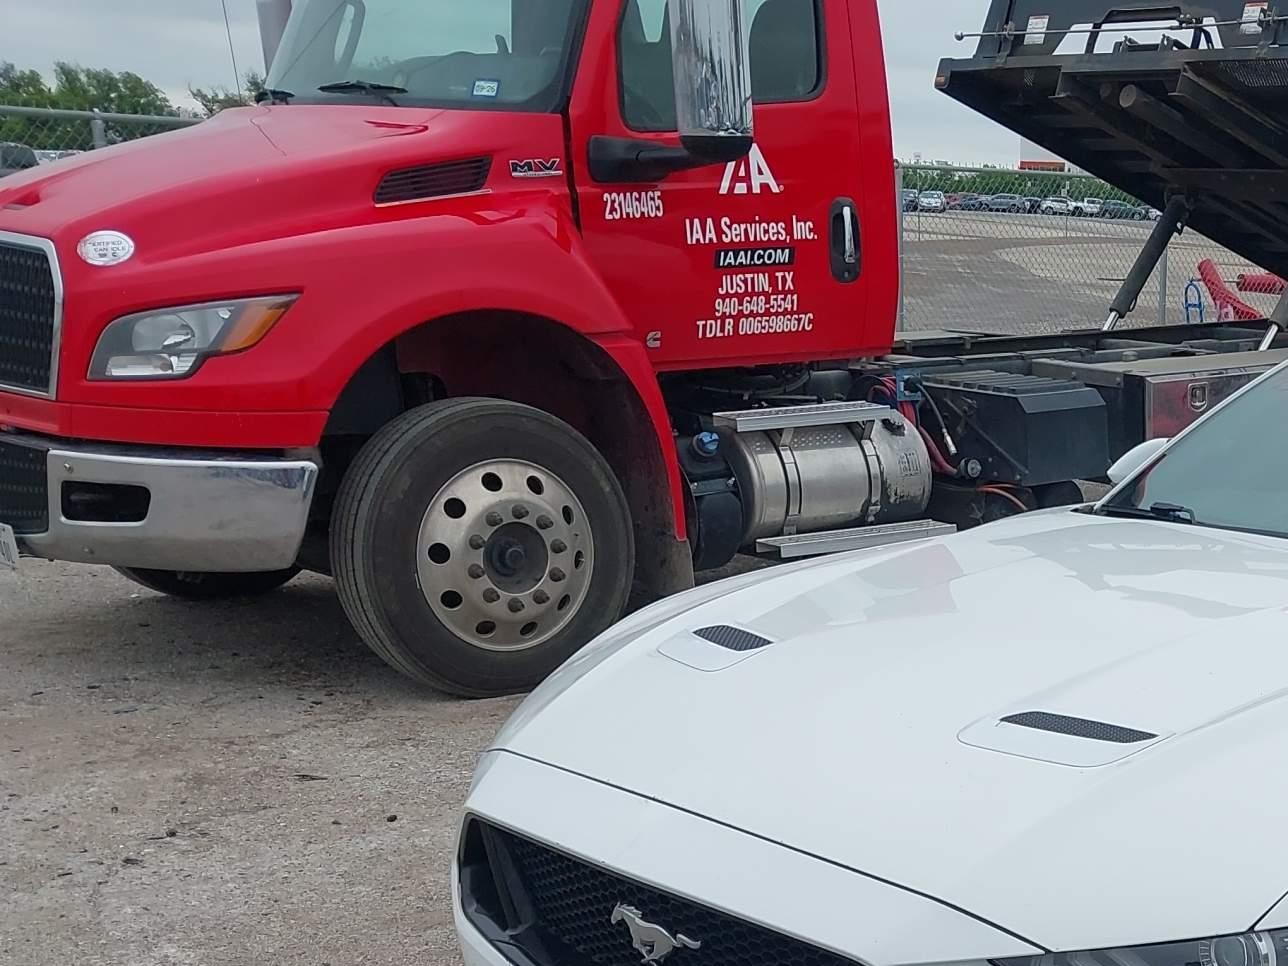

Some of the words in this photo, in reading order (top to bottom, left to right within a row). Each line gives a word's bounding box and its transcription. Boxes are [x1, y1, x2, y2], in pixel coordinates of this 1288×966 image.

[509, 158, 560, 173] MV
[603, 191, 664, 220] 23146465
[685, 218, 717, 245] IAA
[721, 215, 790, 245] Services,
[792, 215, 818, 241] Inc.
[720, 249, 790, 267] IAAI.COM
[718, 272, 773, 295] JUSTIN,
[775, 271, 795, 291] TX
[715, 294, 798, 317] 940-648-5541
[696, 318, 734, 339] TDLR
[738, 313, 814, 336] 006598667C
